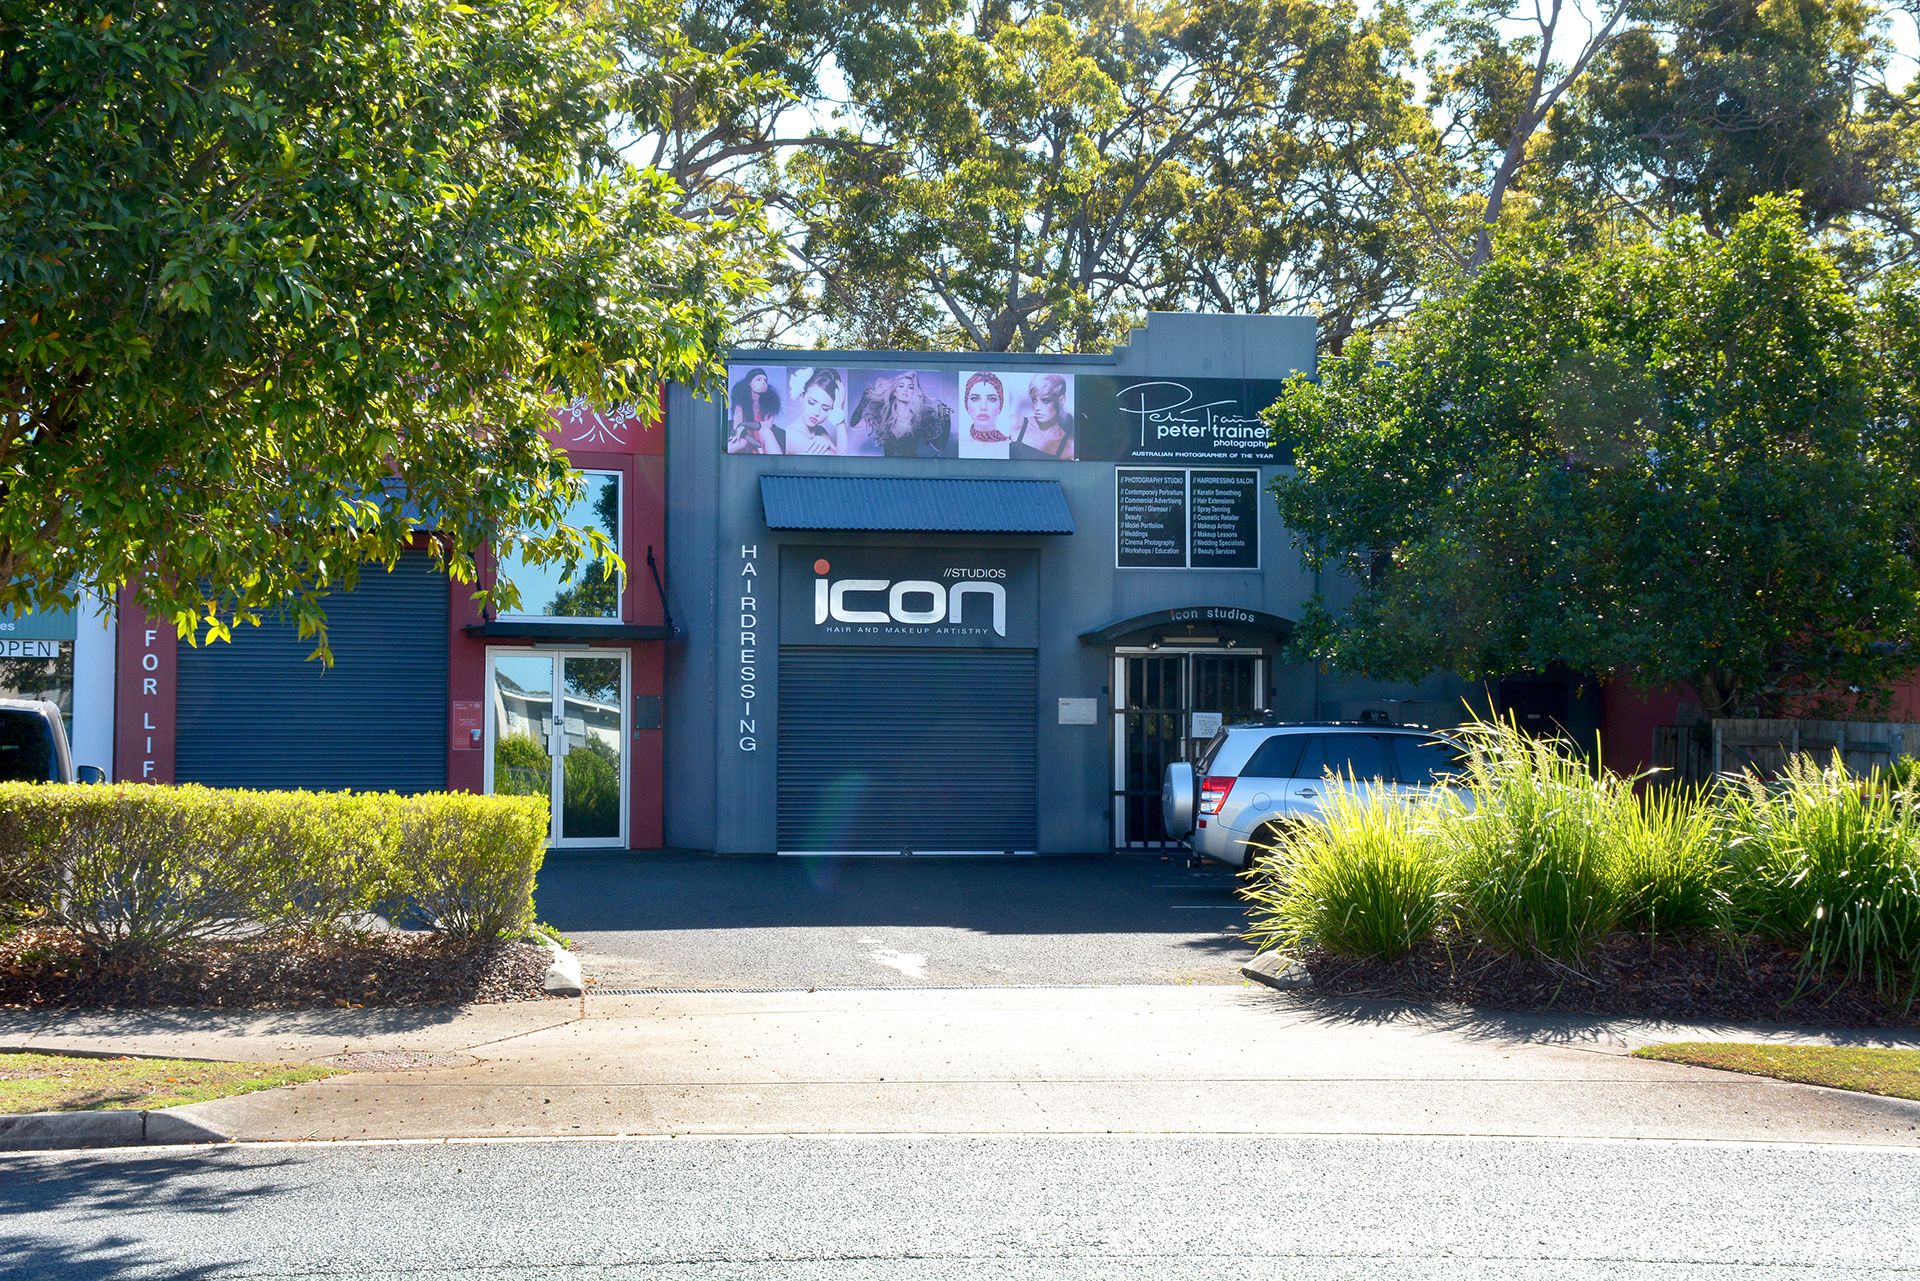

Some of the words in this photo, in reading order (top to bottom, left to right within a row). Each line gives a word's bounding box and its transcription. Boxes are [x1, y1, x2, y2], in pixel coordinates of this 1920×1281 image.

[1157, 423, 1207, 440] peter
[1212, 423, 1271, 438] trainer
[1213, 439, 1270, 450] photography
[1131, 450, 1173, 458] AUSTRALIAN
[1175, 451, 1228, 459] PHOTOGRAPHER
[1124, 476, 1163, 484] PHOTOGRAPHY
[1124, 488, 1158, 496] Contemporary
[1215, 489, 1241, 497] Smoothing
[1154, 497, 1182, 505] Advertising
[1197, 505, 1211, 513] Spray
[1211, 505, 1231, 514] Tanning
[1124, 513, 1142, 521] Beauty
[1124, 530, 1148, 538] Weddings
[1197, 531, 1216, 539] Makeup
[1144, 539, 1175, 547] Photography
[1197, 548, 1214, 556] Beauty
[813, 558, 1007, 637] icon
[1170, 608, 1198, 620] icon
[1206, 607, 1255, 623] studios
[857, 626, 879, 634] AND
[739, 544, 758, 751] HAIRDRESSING
[142, 629, 159, 695] FOR
[142, 712, 156, 778] LIF
